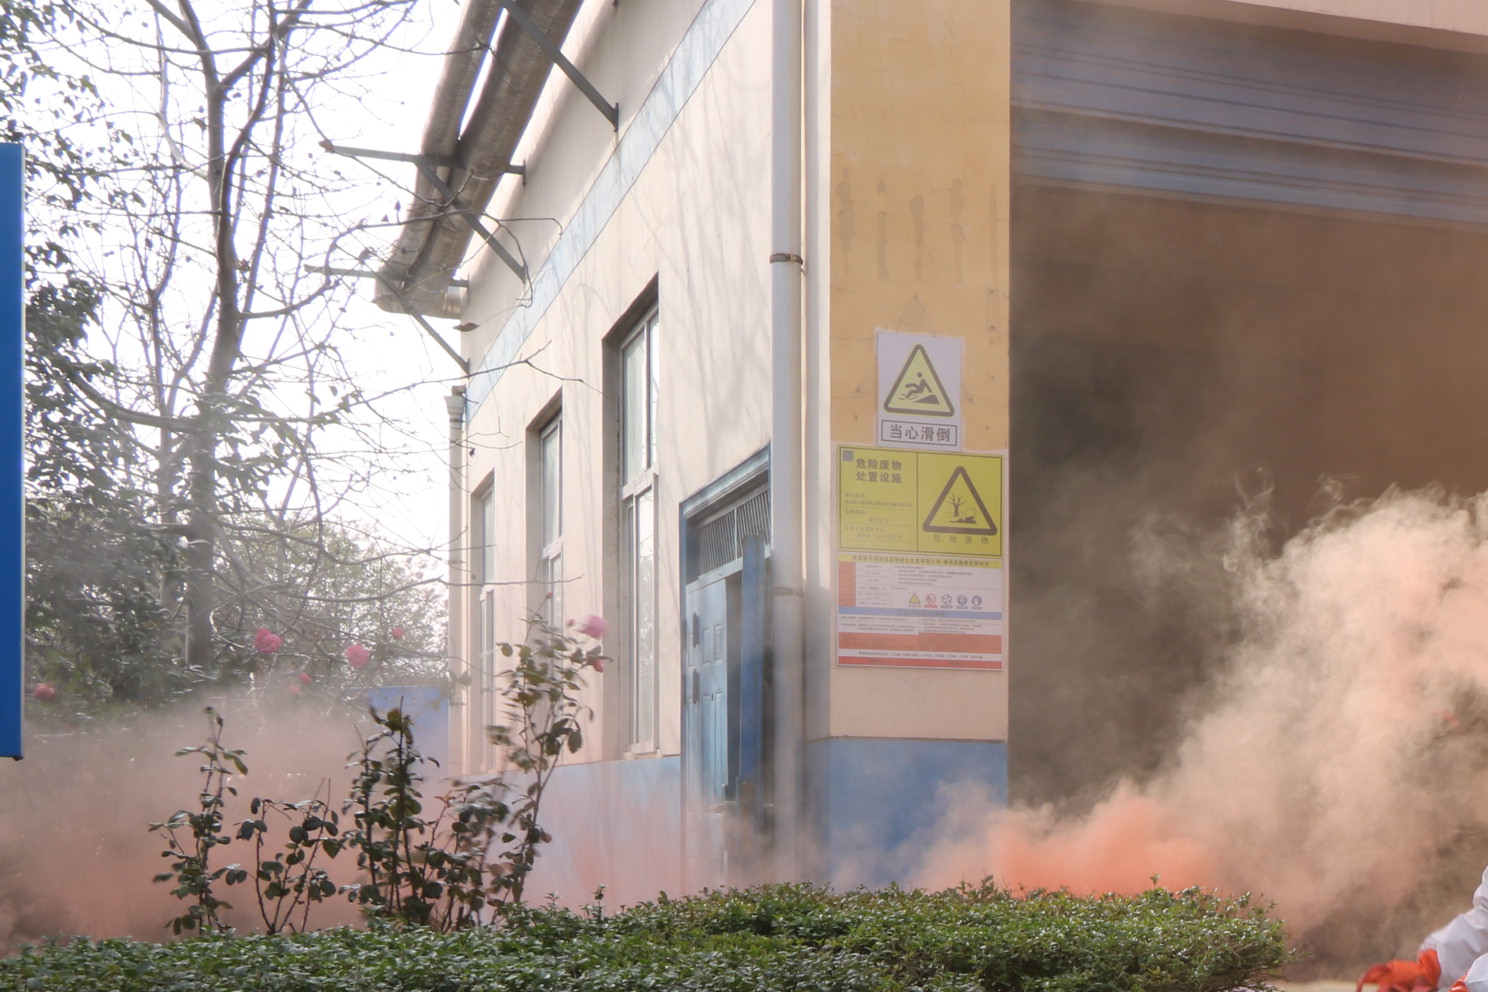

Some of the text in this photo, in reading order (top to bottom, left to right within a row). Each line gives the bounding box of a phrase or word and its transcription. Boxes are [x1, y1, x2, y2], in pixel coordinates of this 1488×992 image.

[889, 423, 951, 443] 当心滑倒
[856, 457, 902, 471] 危险废物
